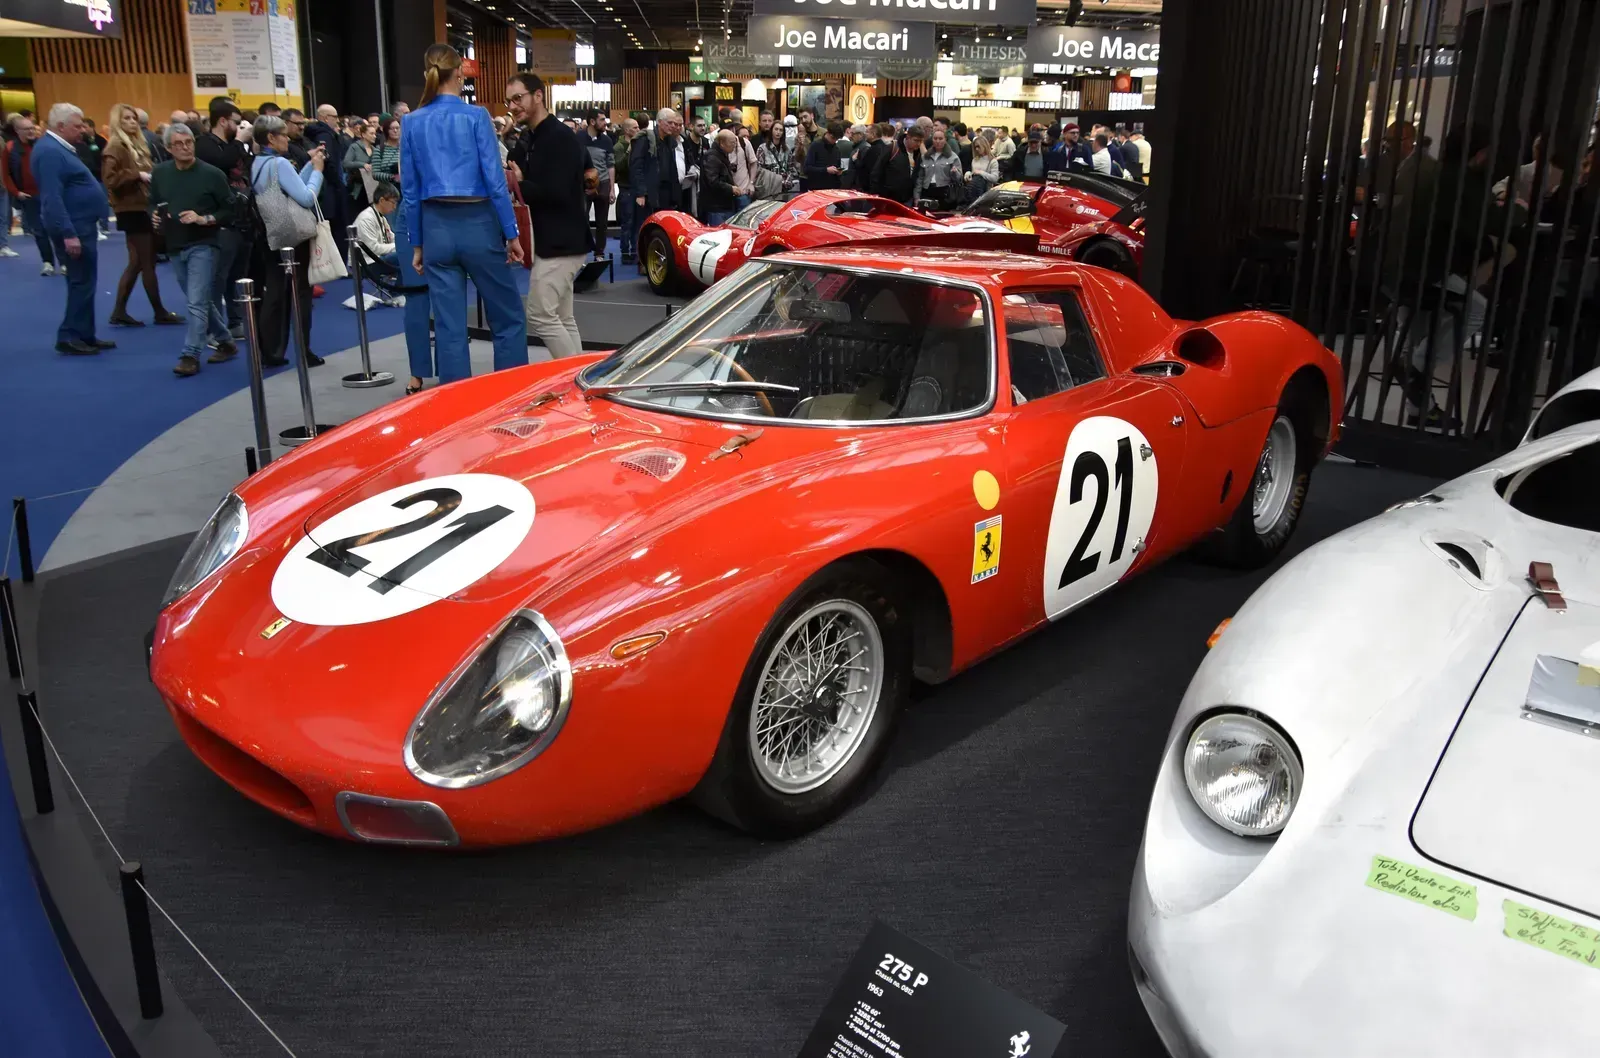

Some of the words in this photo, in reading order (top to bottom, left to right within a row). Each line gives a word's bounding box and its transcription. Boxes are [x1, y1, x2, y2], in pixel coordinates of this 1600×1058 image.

[774, 24, 817, 49] Joe
[823, 25, 909, 51] Macari
[959, 44, 1027, 61] THIESEN
[1052, 33, 1094, 58] Joe
[1100, 35, 1160, 61] Maca
[799, 57, 838, 65] AUTOMOBILE
[1083, 207, 1100, 216] AT&T
[1052, 246, 1072, 256] MILLE
[1058, 435, 1134, 590] 21
[306, 487, 516, 596] 21
[1377, 858, 1404, 874] Tubi
[879, 953, 914, 982] 275
[912, 972, 929, 988] P
[867, 982, 884, 997] 1963
[875, 969, 894, 984] Chassis
[892, 980, 901, 989] no.
[900, 984, 914, 996] 0812
[861, 1001, 871, 1012] V12
[853, 1015, 864, 1026] 320
[862, 1022, 871, 1031] hp
[889, 1040, 901, 1050] rpm
[833, 1041, 847, 1052] raced
[845, 1048, 852, 1056] by
[837, 1034, 854, 1048] Chassis
[867, 1035, 887, 1050] manual
[830, 1047, 839, 1055] car
